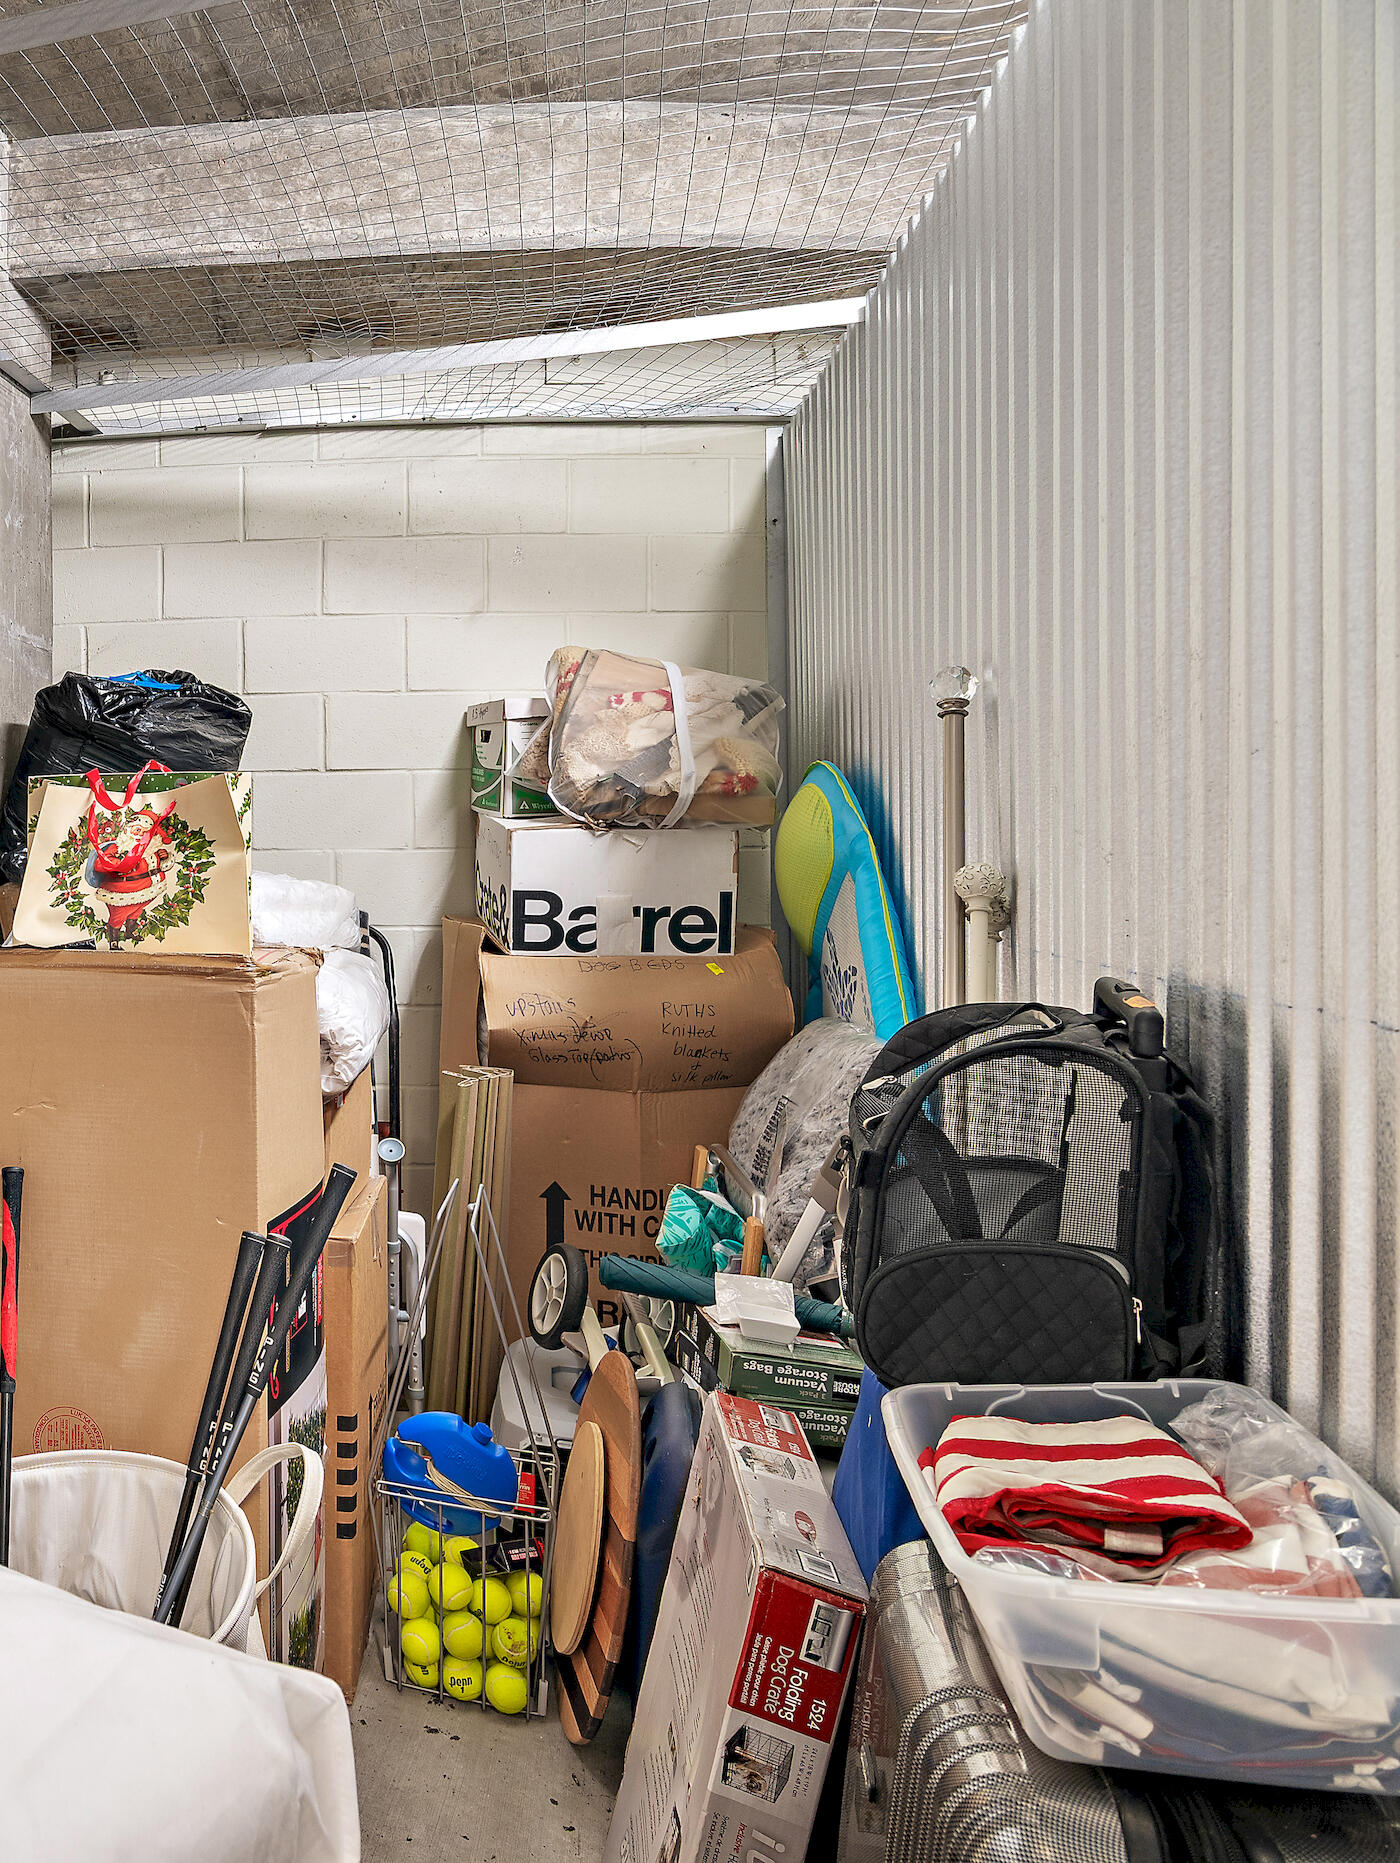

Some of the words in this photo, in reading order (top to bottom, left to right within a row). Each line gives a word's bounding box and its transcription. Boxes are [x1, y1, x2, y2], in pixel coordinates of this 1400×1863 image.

[512, 889, 734, 954] Barel
[590, 1184, 668, 1211] HANDL
[574, 1209, 635, 1237] WITH
[248, 1336, 275, 1385] PING
[743, 1360, 773, 1374] Bags
[777, 1364, 828, 1381] Storage
[774, 1376, 827, 1392] Vacuum
[799, 1390, 819, 1399] Pack
[799, 1409, 848, 1425] Storage
[200, 1421, 217, 1472] PING
[771, 1644, 795, 1675] Dog
[764, 1676, 787, 1714] Crate
[778, 1667, 809, 1722] Folding
[807, 1698, 827, 1731] 1524
